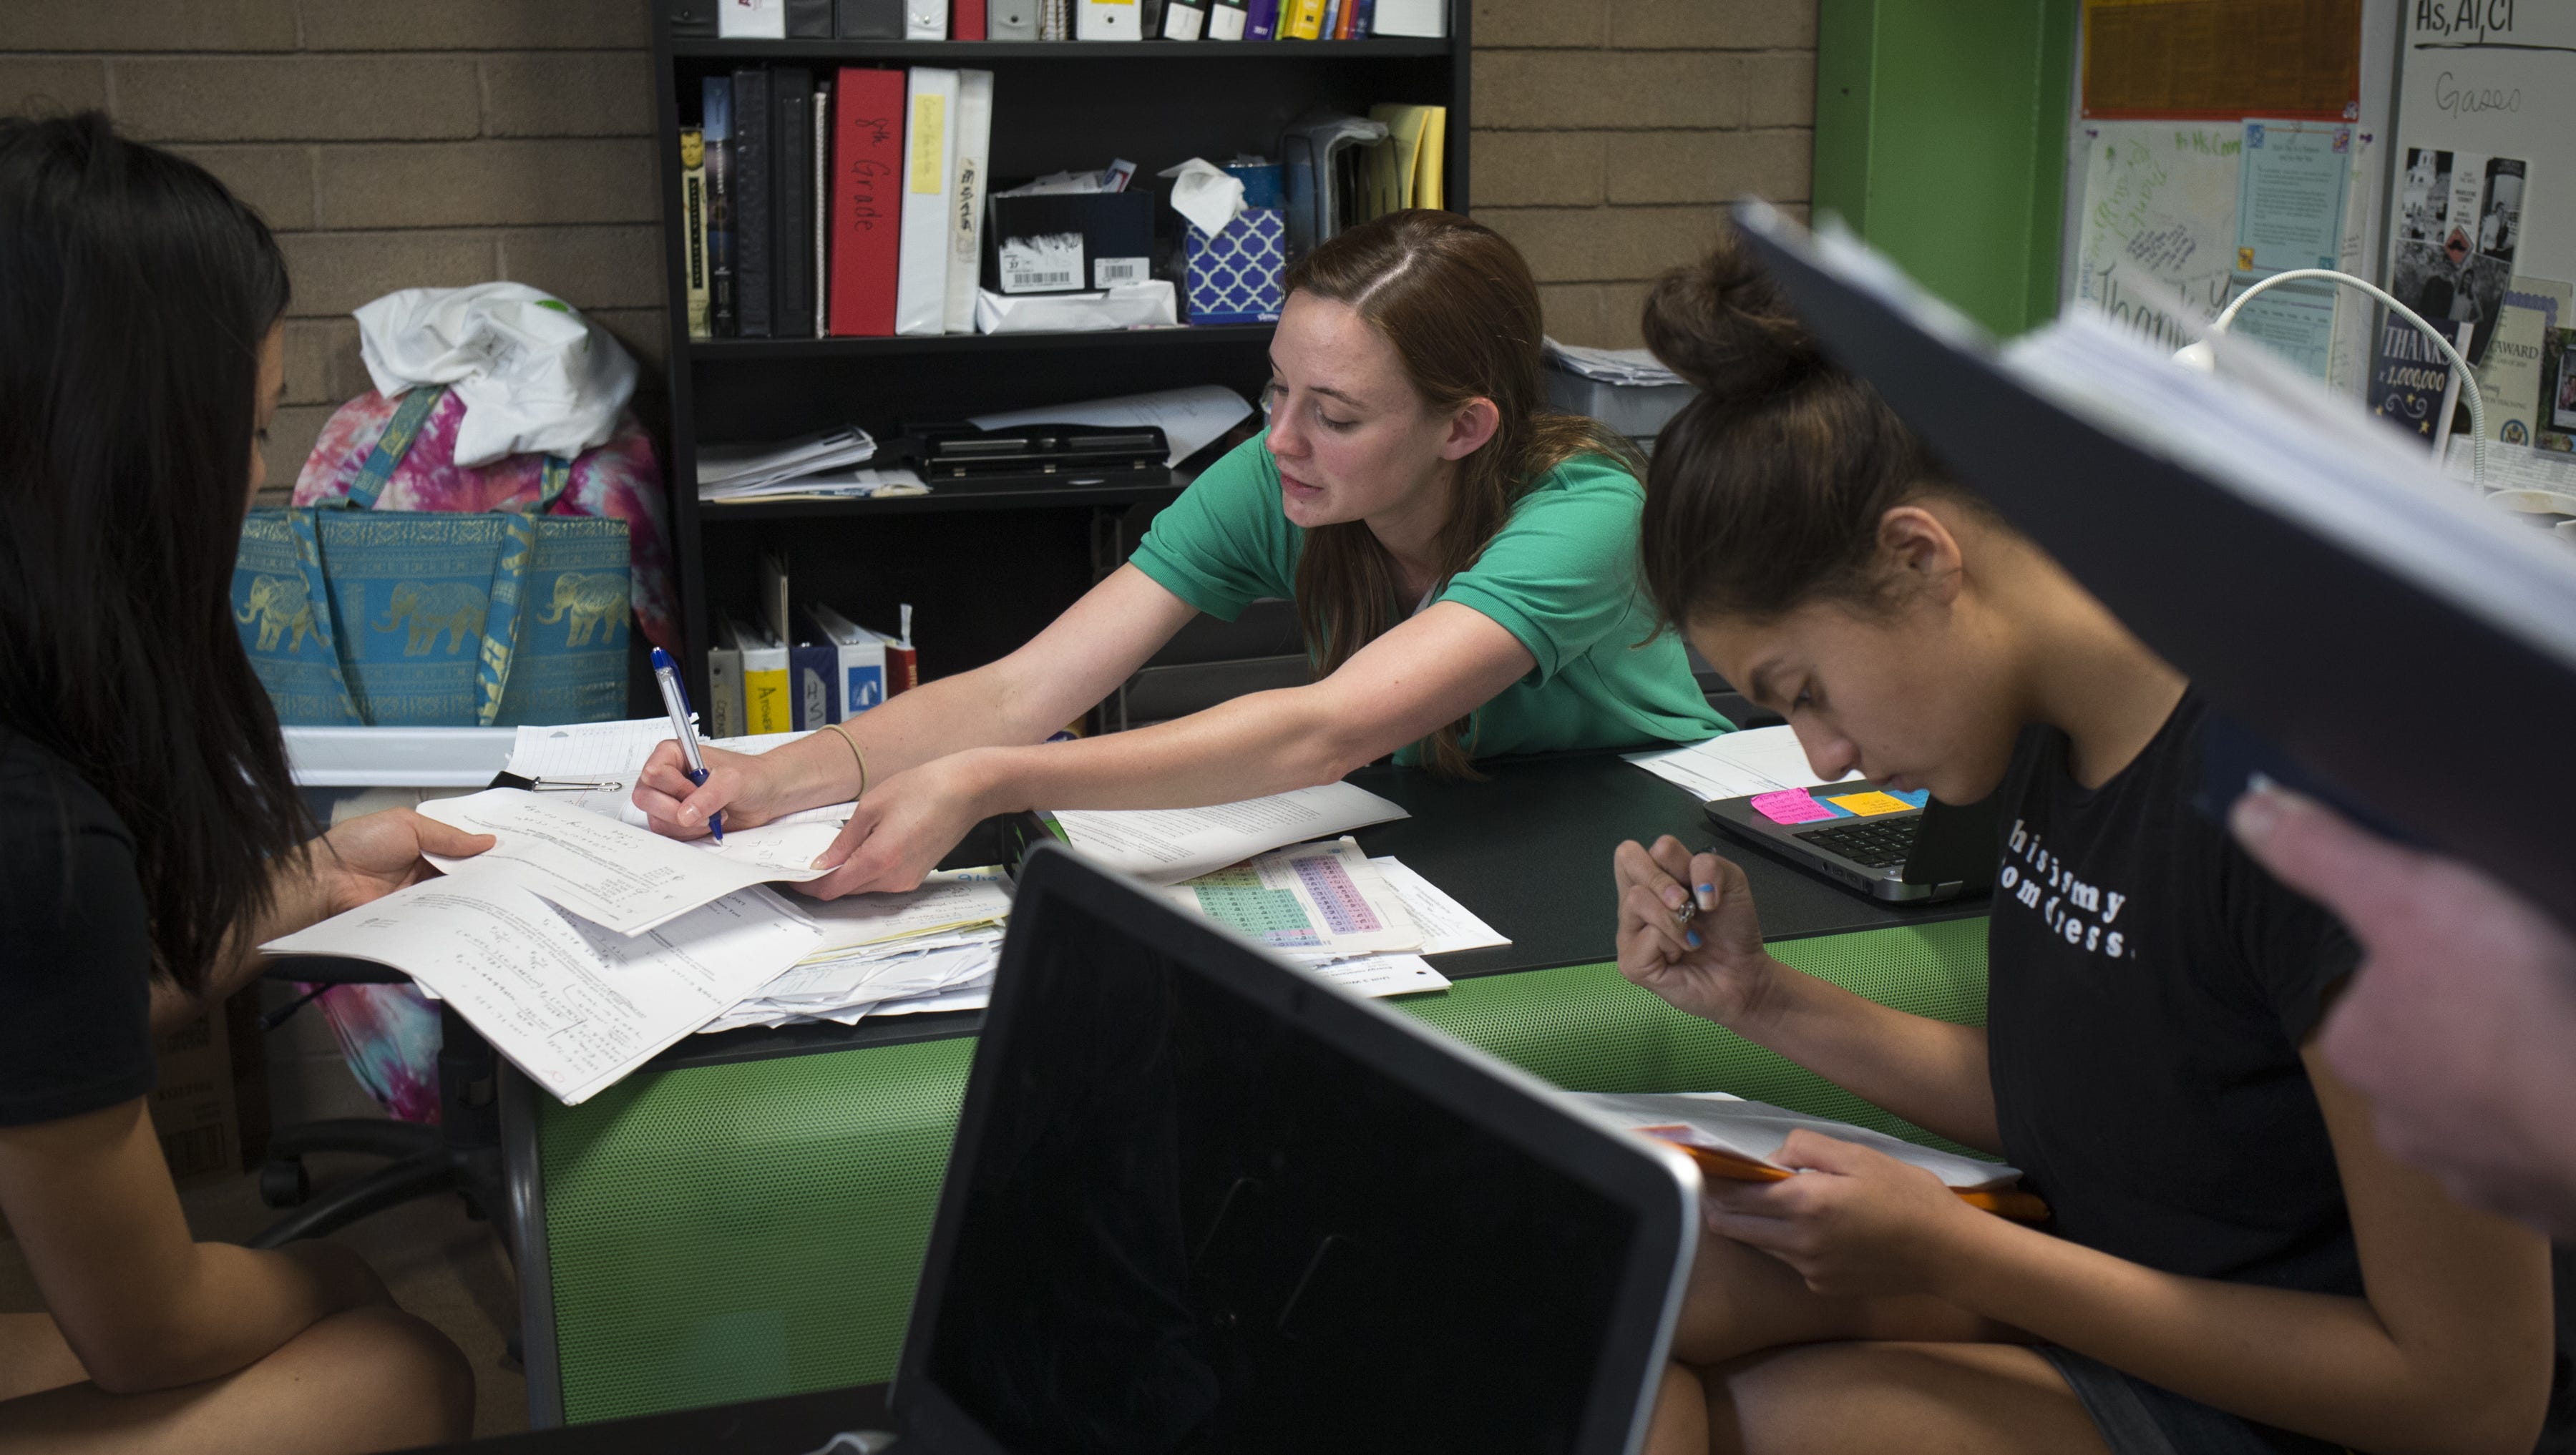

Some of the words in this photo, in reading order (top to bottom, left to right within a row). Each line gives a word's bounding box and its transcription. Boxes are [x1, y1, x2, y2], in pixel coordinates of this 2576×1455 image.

[851, 159, 891, 232] Grade
[2001, 864, 2042, 909] om
[2009, 818, 2049, 873] his
[2069, 880, 2126, 924] my
